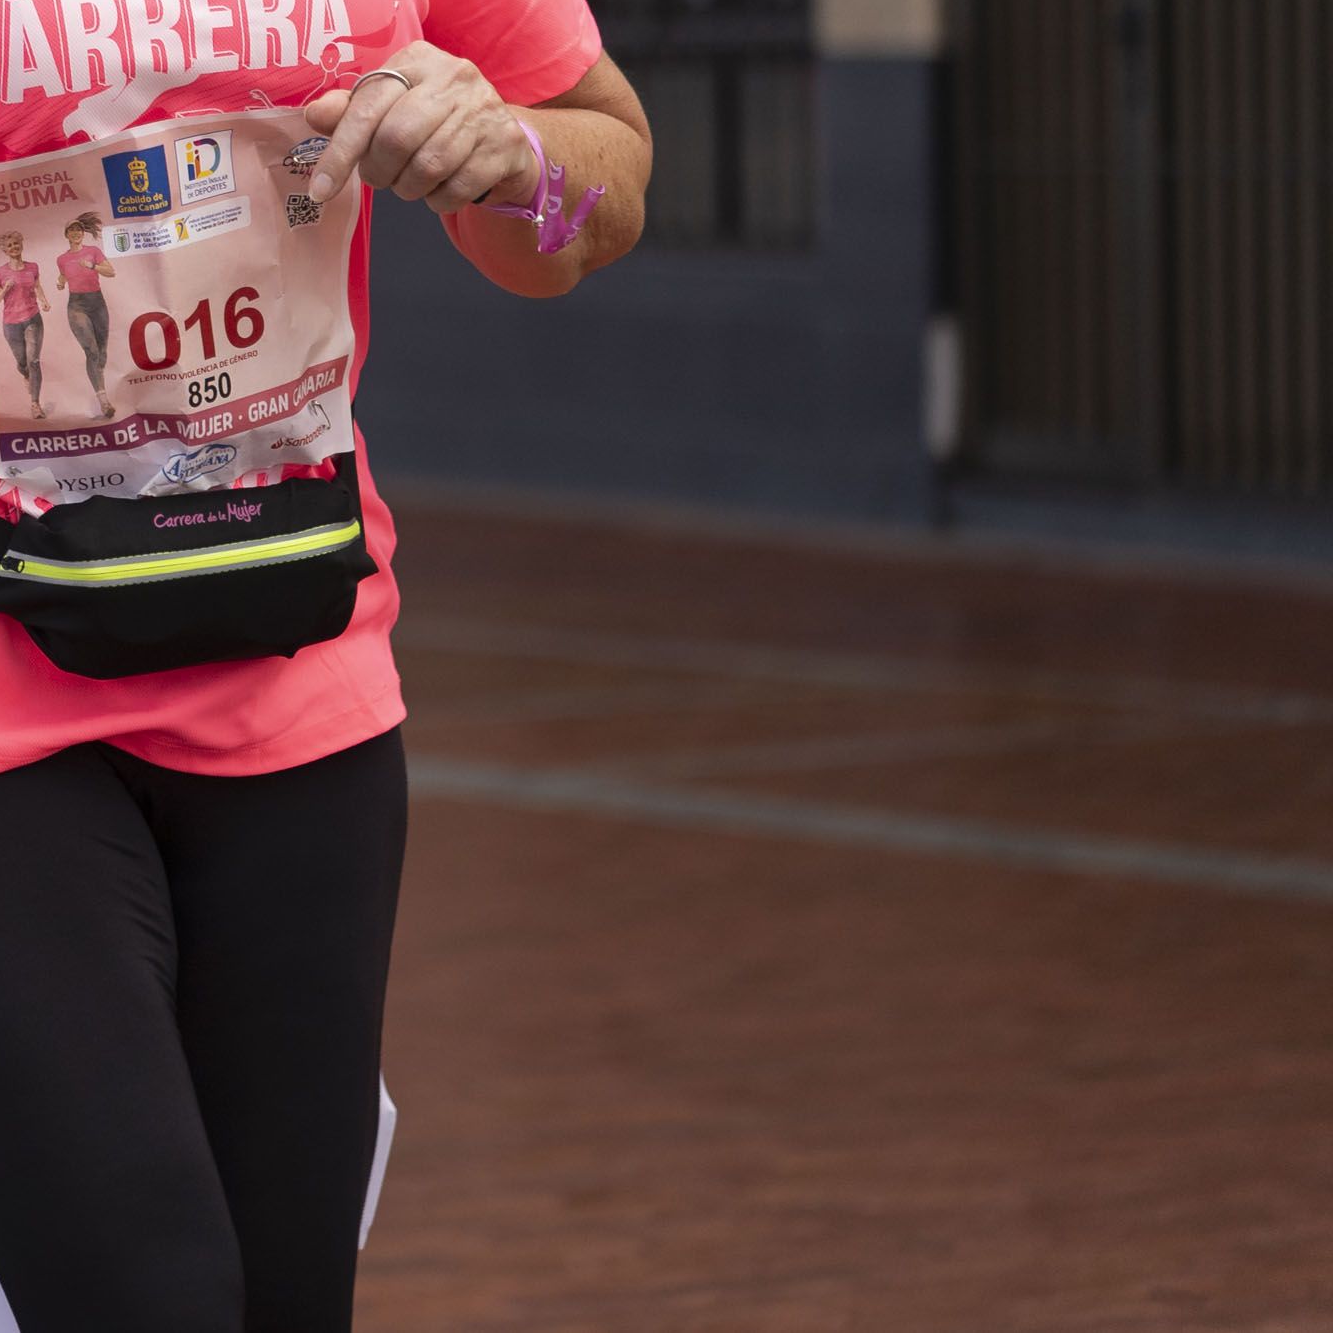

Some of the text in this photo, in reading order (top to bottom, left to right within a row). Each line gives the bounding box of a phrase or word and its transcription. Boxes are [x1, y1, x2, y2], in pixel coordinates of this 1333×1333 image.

[10, 171, 74, 191] DORSAL
[117, 200, 169, 213] Gran Canaria
[119, 192, 163, 205] Cabildo de
[128, 286, 265, 372] 016
[128, 349, 258, 386] TELÉFONO VIOLENCIA DE GÉNERO
[188, 371, 232, 408] 850
[11, 368, 337, 456] CARRERA DE LA MUJER GRAN CANARIA
[58, 473, 125, 494] YSHO
[154, 499, 263, 528] Carrera de la Mujer
